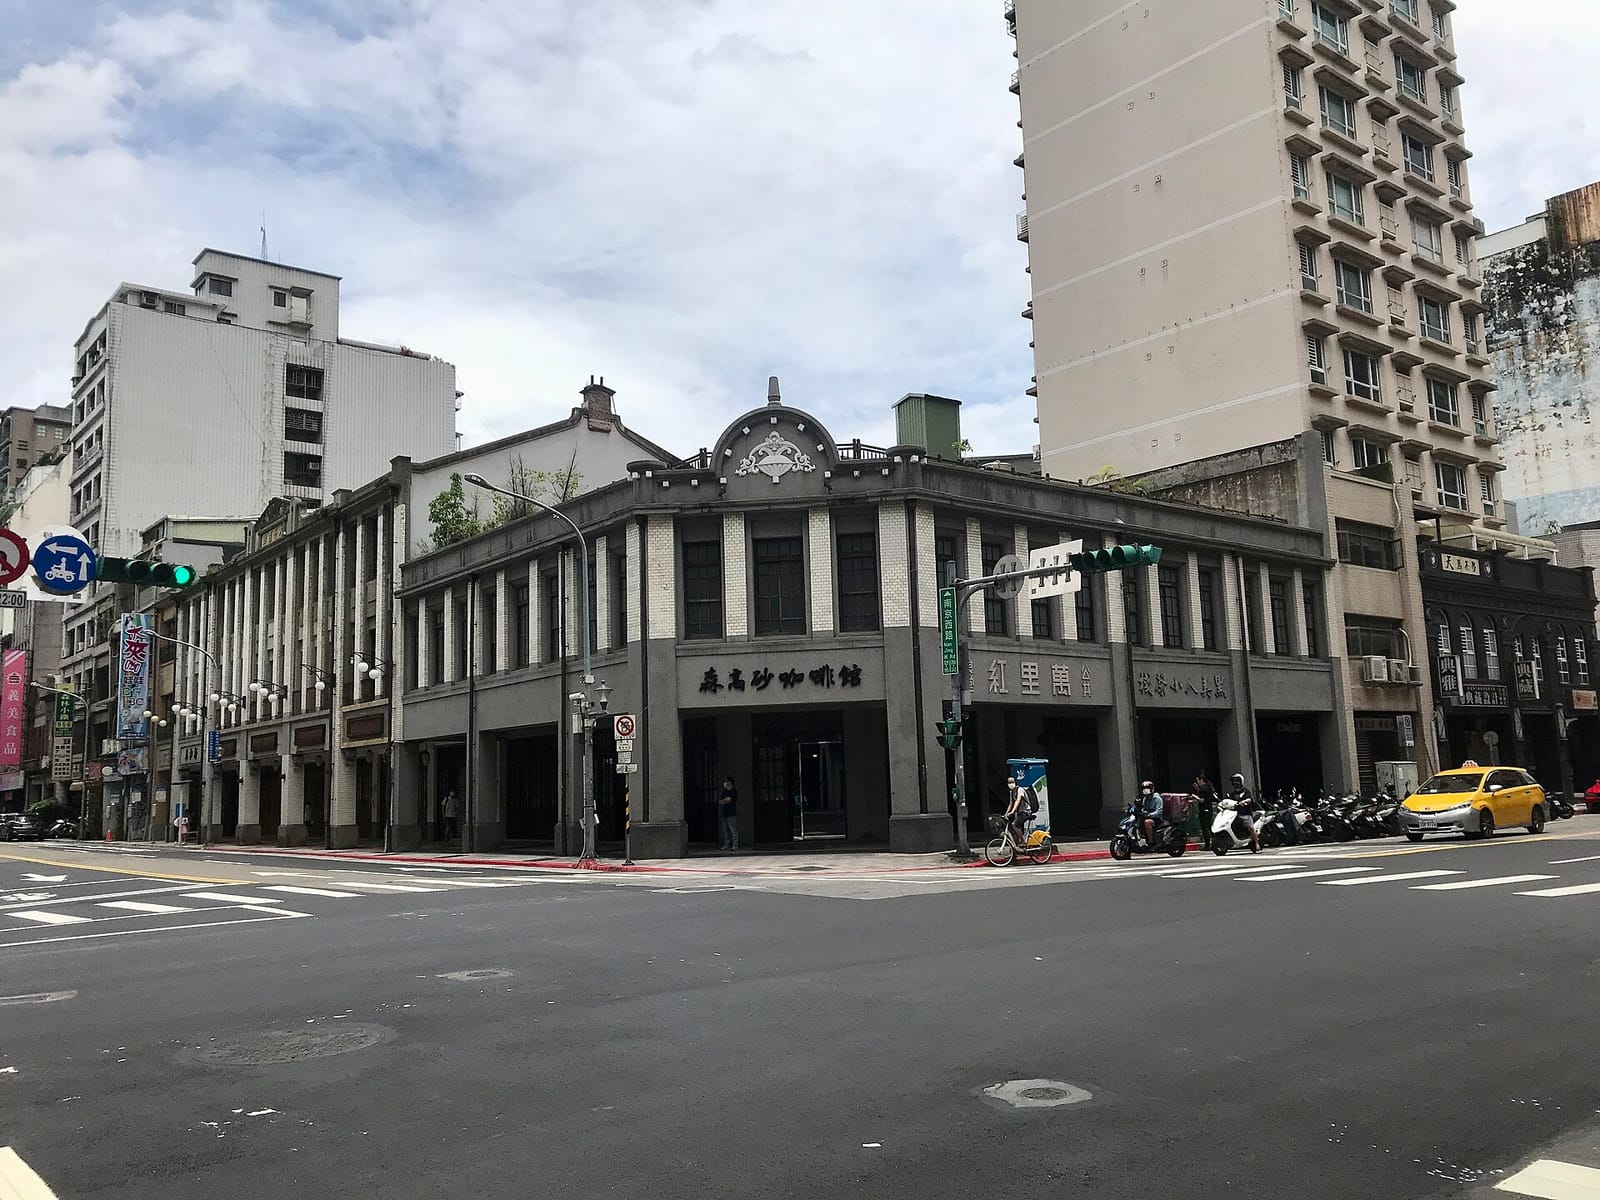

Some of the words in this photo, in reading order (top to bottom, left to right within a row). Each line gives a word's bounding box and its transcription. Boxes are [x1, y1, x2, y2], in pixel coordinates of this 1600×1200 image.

[0, 594, 23, 605] 2:00
[699, 664, 863, 693] 森高砂咖啡館
